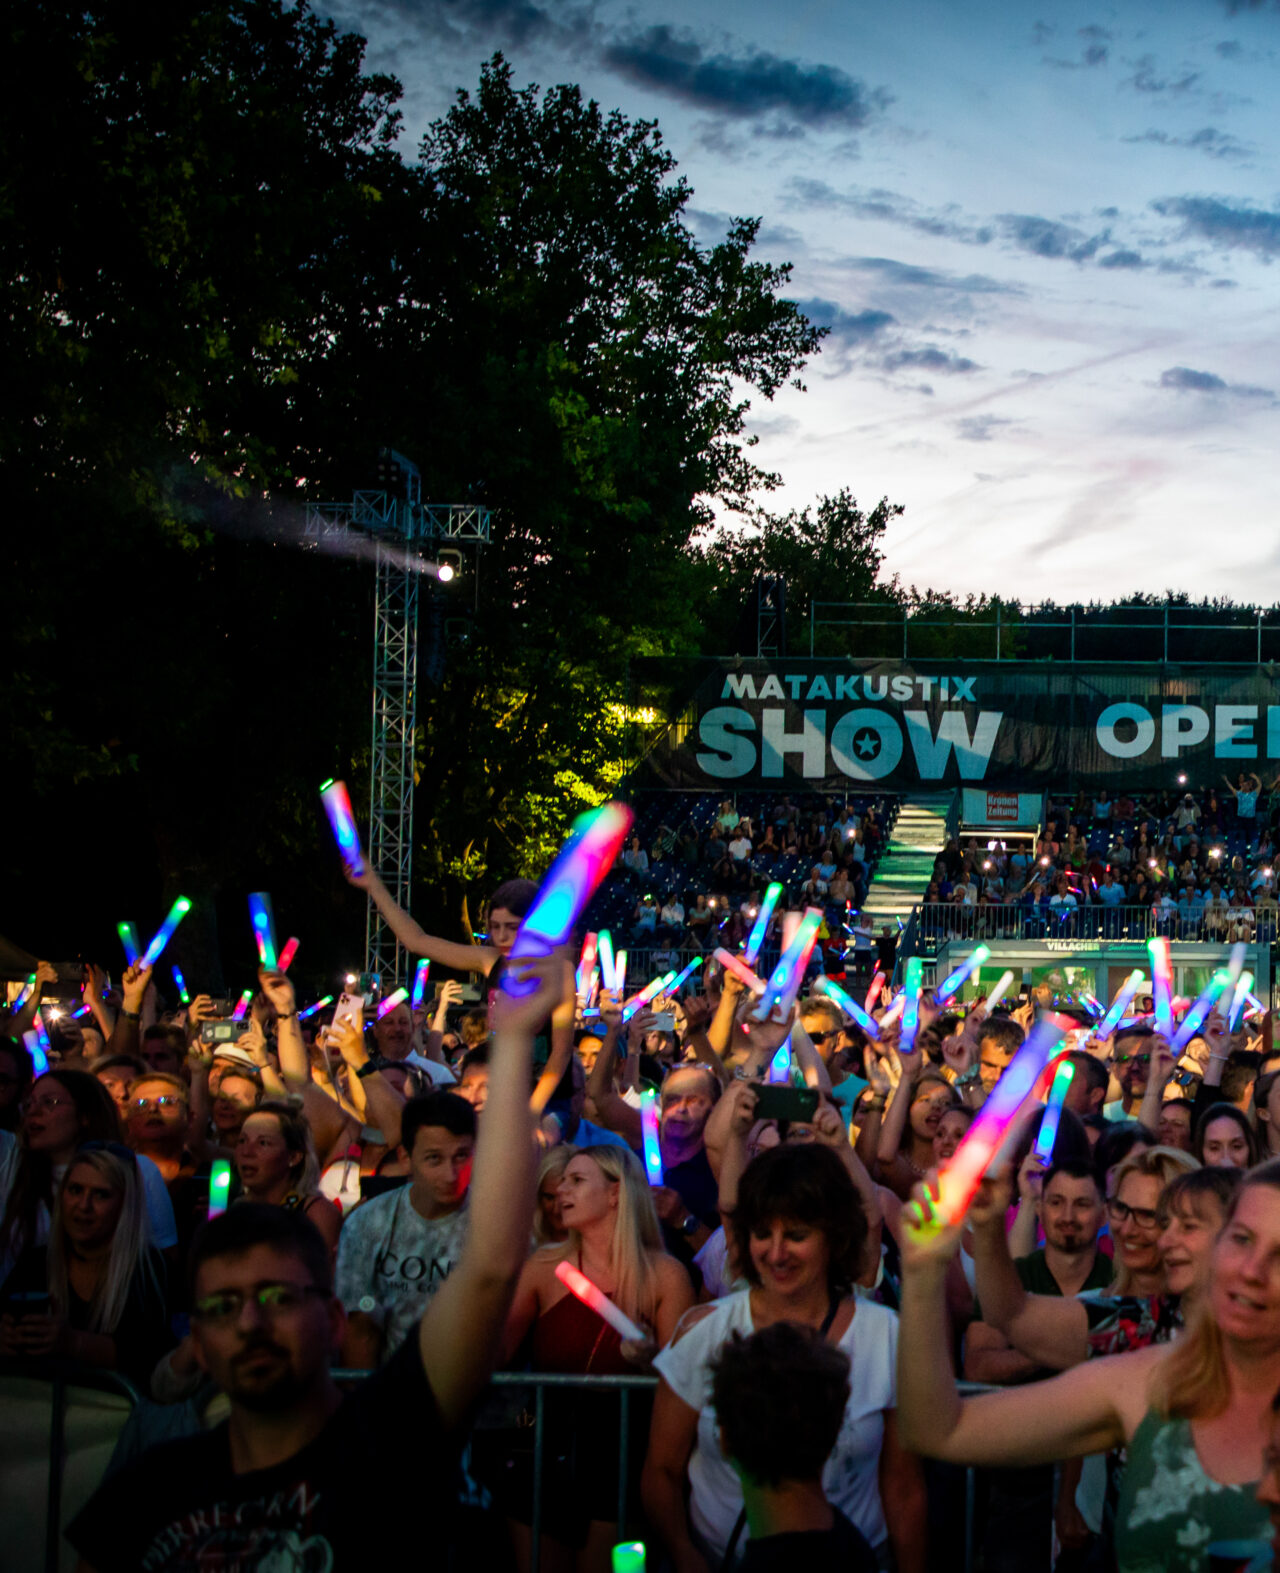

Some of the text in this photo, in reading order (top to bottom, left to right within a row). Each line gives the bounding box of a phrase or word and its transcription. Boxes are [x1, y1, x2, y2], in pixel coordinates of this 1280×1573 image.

[720, 673, 978, 702] MATAKUSTIX
[695, 706, 1004, 781] SHOW
[1047, 942, 1101, 951] VILLACHER
